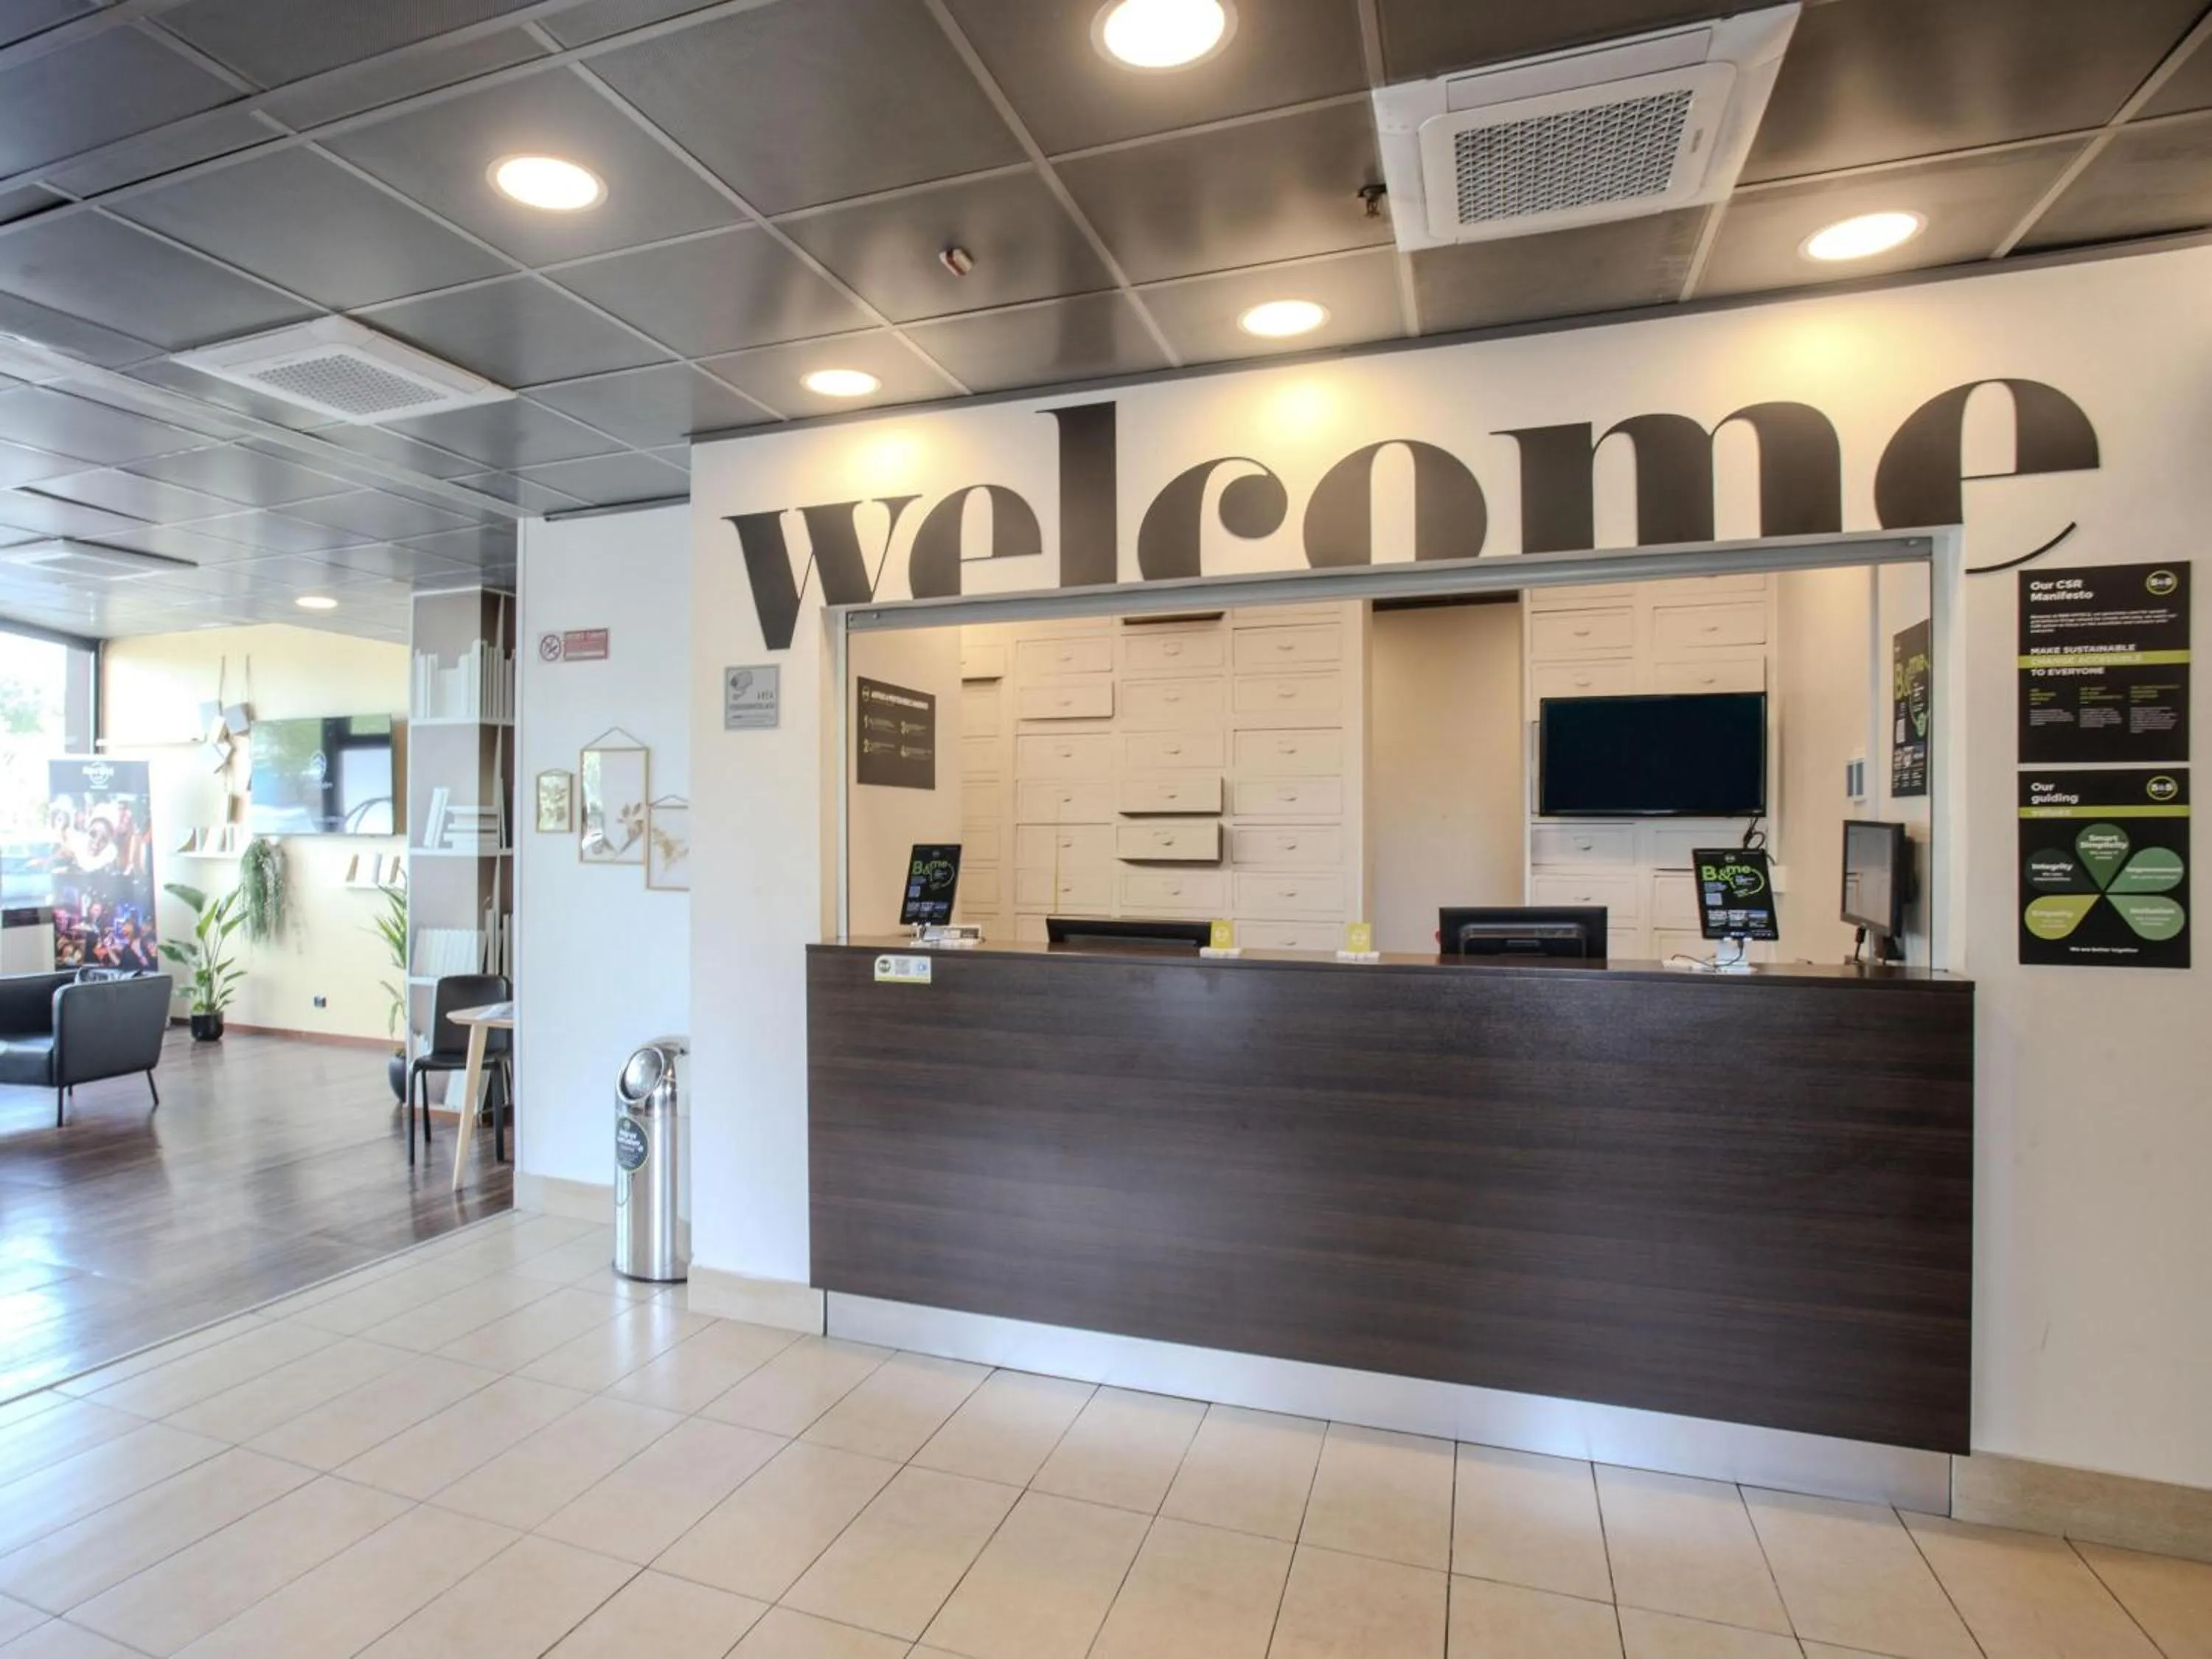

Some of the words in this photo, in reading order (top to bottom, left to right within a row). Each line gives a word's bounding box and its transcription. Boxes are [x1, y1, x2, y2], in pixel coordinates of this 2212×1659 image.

[722, 378, 2100, 649] welcome
[2030, 580, 2053, 591] Our
[2056, 579, 2083, 589] CSR
[2031, 591, 2094, 602] Manifesto
[2030, 647, 2061, 655] MAKE
[2063, 644, 2136, 654] SUSTAINABLE
[2031, 668, 2046, 676] TO
[2047, 667, 2105, 676] EVERYONE
[2031, 782, 2055, 792] Our
[2031, 793, 2079, 804] guiding
[2031, 863, 2073, 872] Integrity
